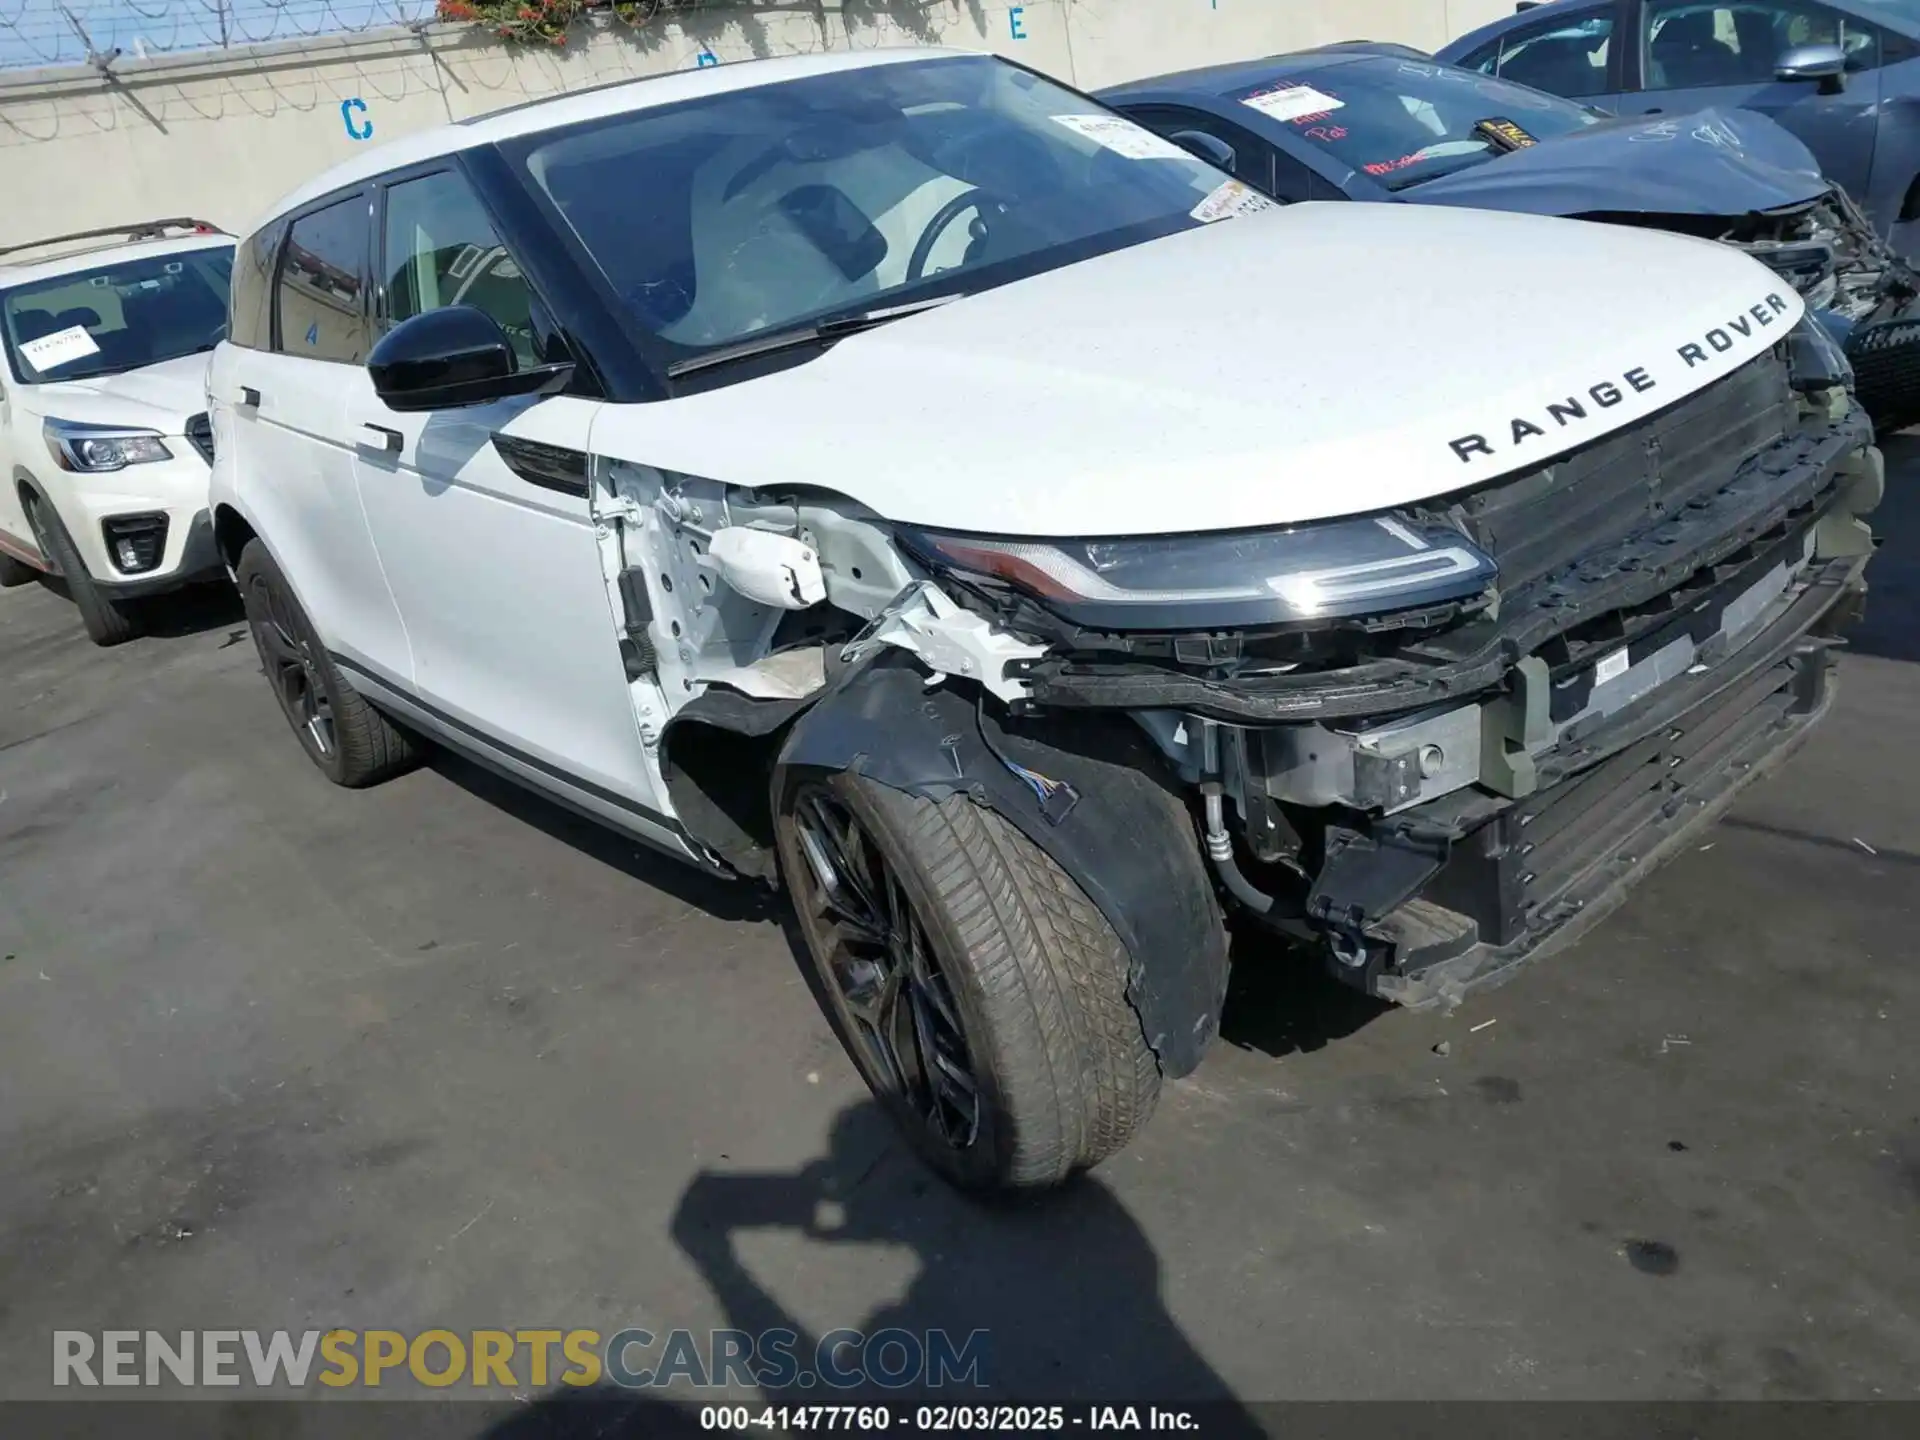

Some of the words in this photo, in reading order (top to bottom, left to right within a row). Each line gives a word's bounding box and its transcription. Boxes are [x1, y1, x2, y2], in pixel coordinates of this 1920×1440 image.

[1009, 7, 1027, 40] E
[341, 98, 373, 140] C
[1448, 366, 1656, 463] RANGE
[1676, 292, 1788, 367] ROVER
